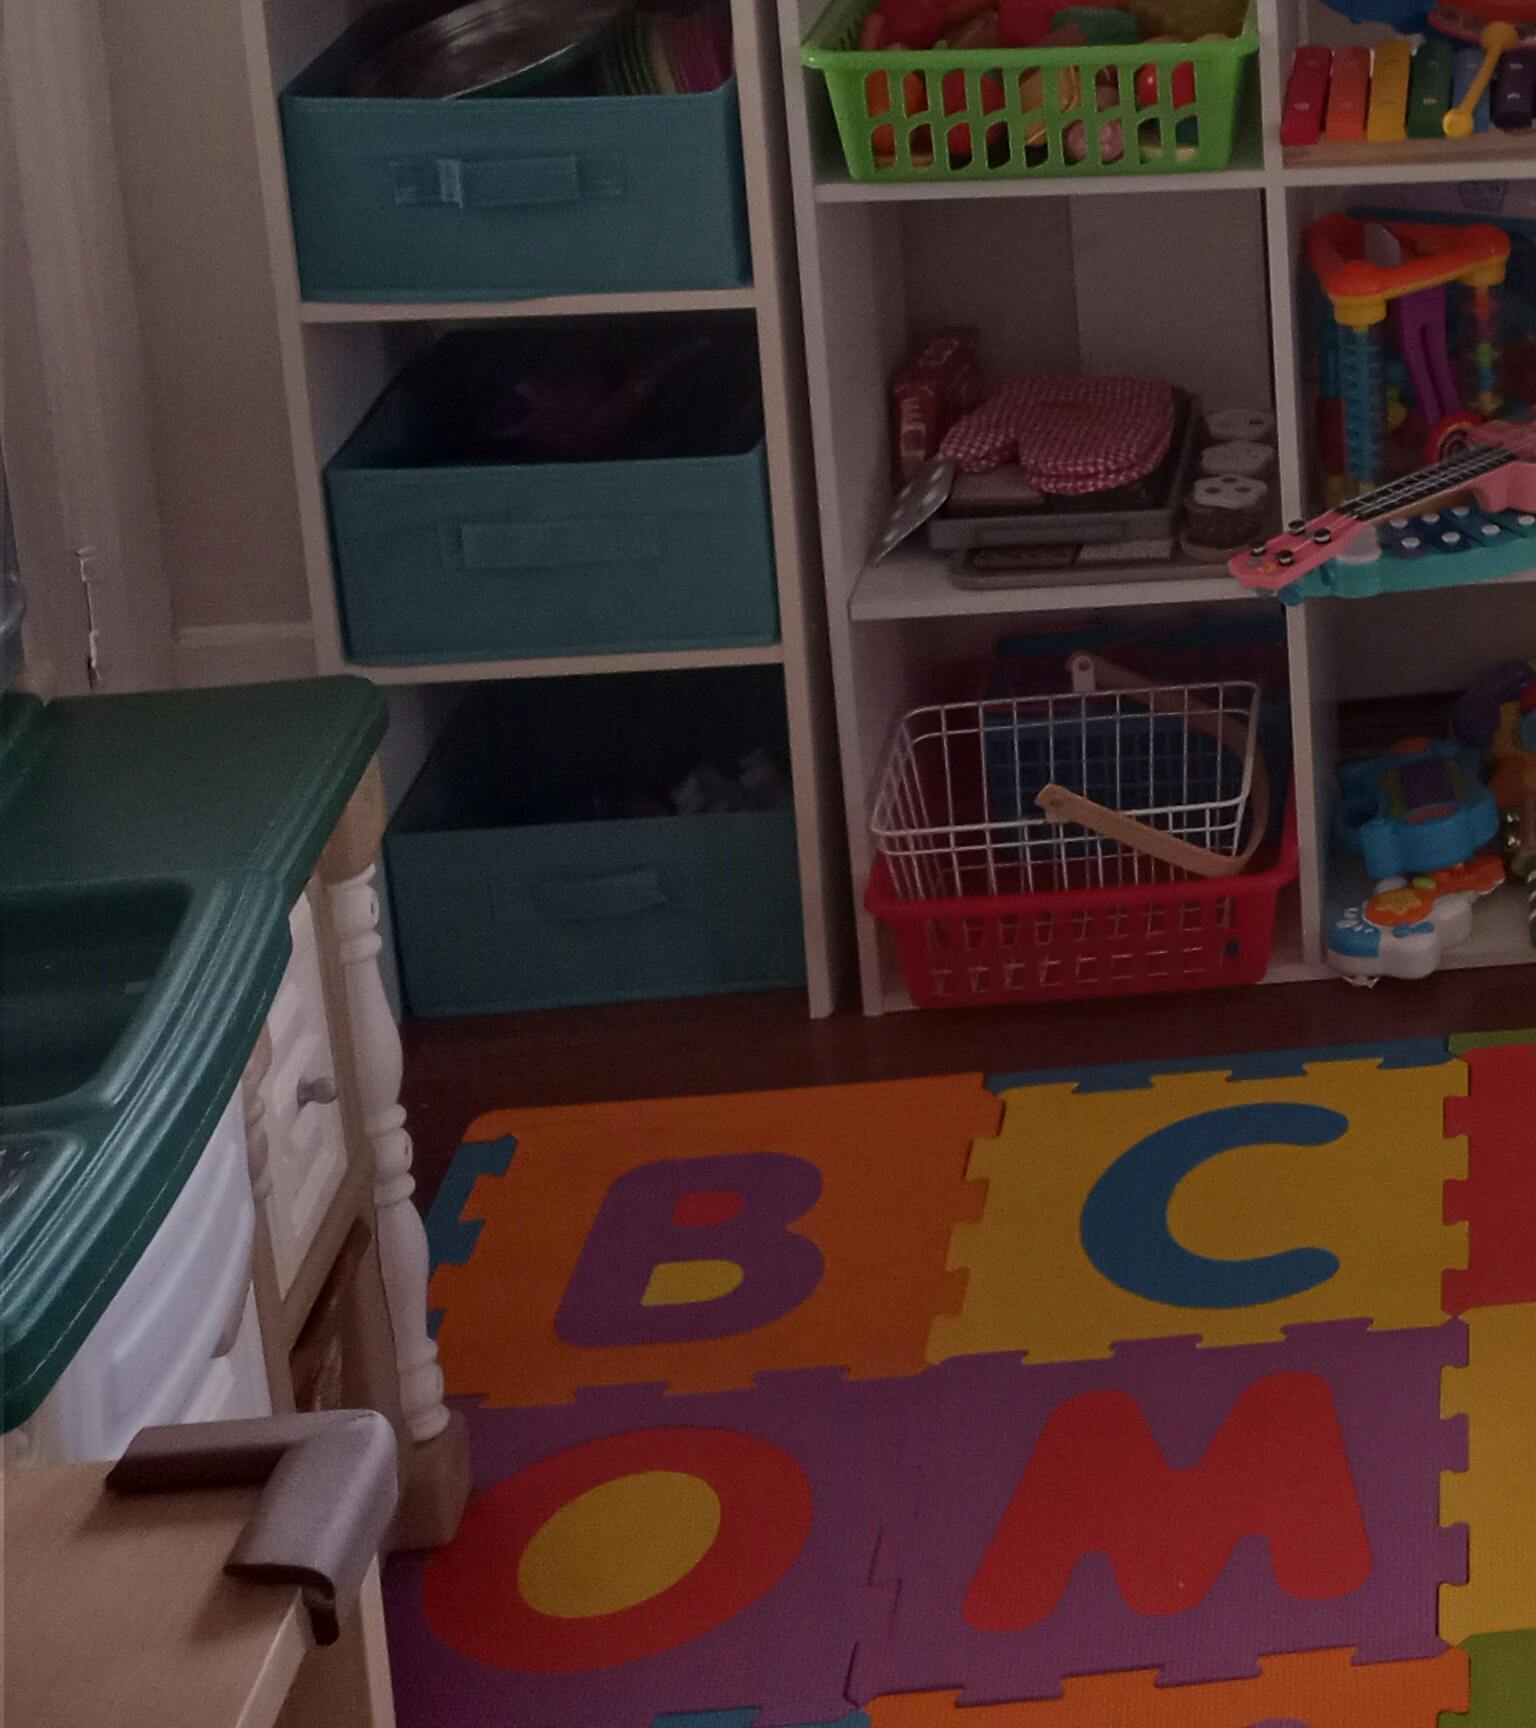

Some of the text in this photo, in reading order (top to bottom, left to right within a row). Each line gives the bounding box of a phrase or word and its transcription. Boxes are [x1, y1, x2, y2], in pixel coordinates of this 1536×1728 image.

[553, 1152, 825, 1349] B
[1079, 1102, 1349, 1309] C
[422, 1426, 813, 1673] O
[962, 1371, 1372, 1632] M
